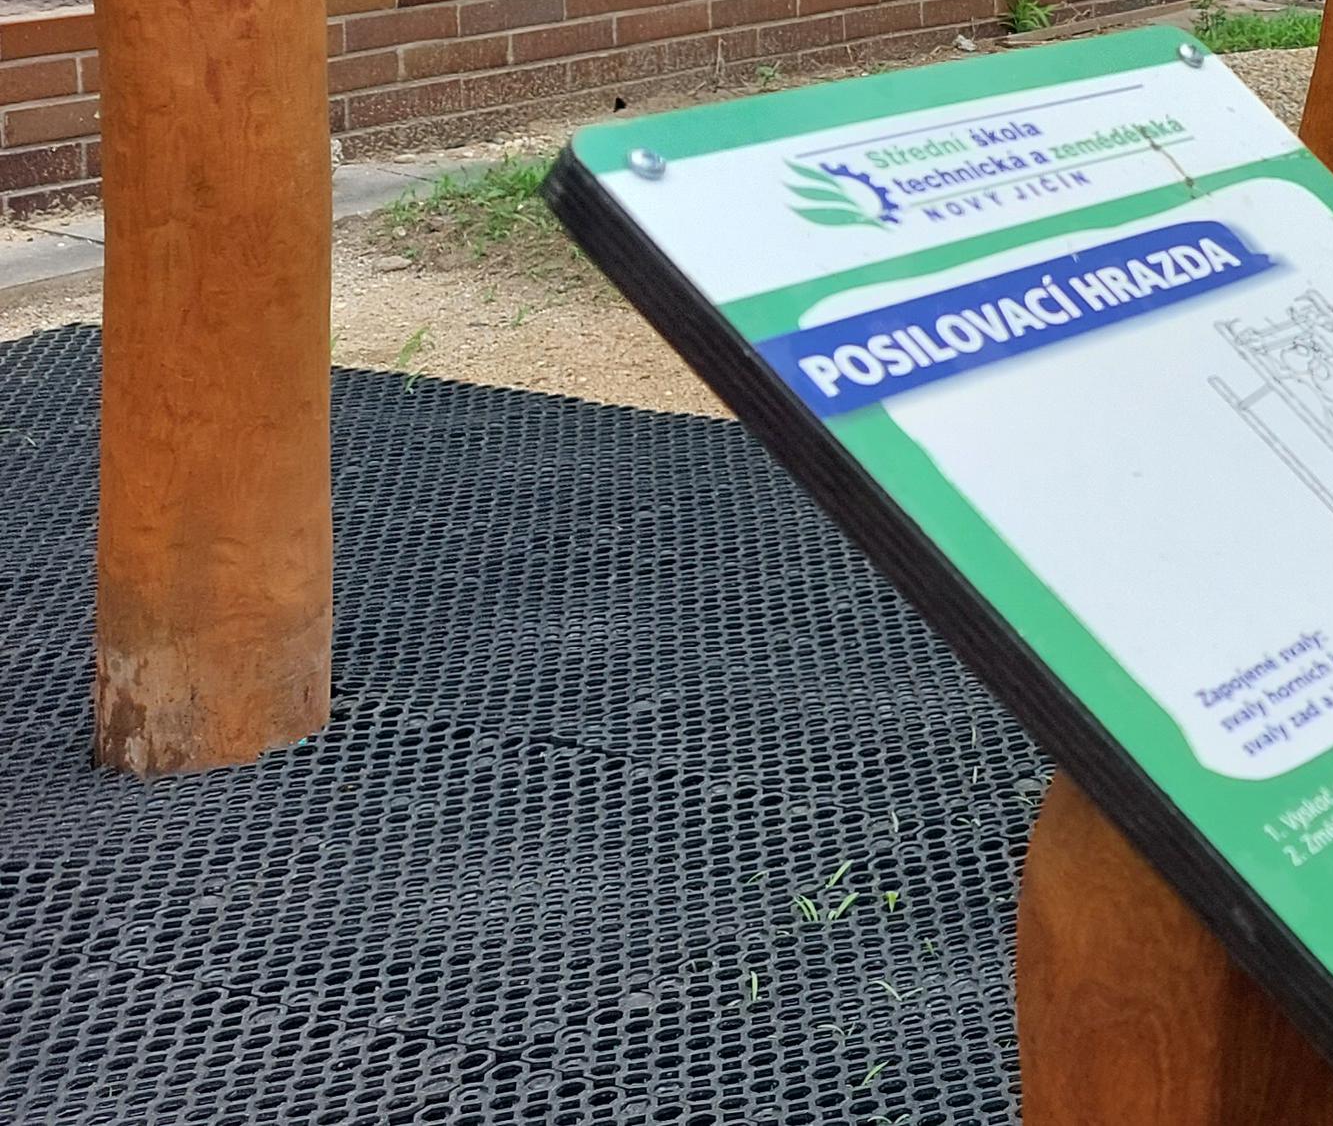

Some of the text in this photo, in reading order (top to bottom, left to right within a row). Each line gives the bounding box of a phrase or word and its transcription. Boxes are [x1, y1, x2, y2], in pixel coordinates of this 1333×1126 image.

[865, 121, 1042, 169] Střední škola
[892, 151, 1027, 196] technická
[1029, 148, 1048, 165] a
[922, 170, 1091, 222] NOVÝ JIČÍN
[799, 237, 1243, 399] POSILOVACÍ HRAZDA
[1195, 653, 1278, 707] Zapojené
[1221, 700, 1267, 732] svaly
[1243, 723, 1290, 756] svaly
[1289, 700, 1322, 728] zad
[1282, 845, 1308, 866] 2.
